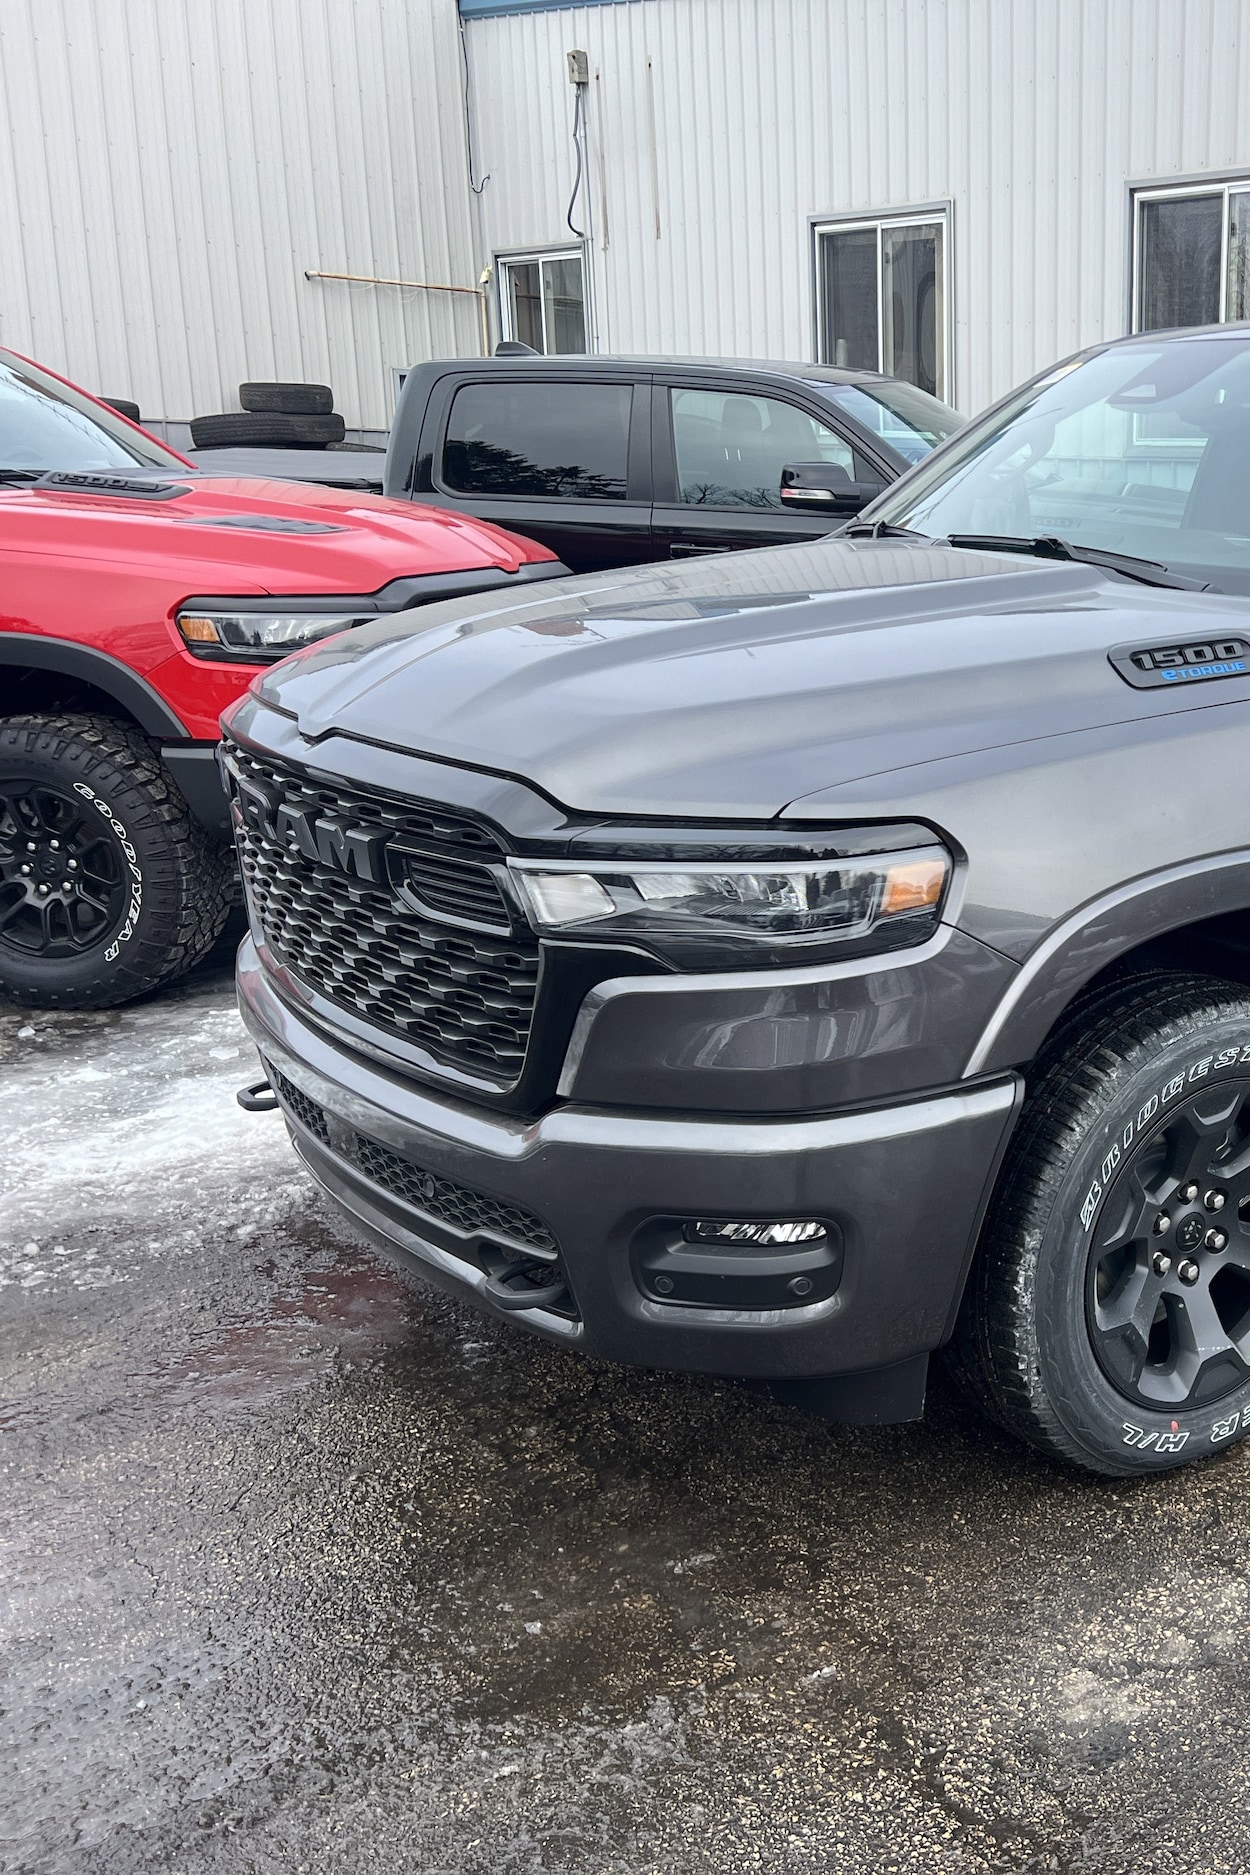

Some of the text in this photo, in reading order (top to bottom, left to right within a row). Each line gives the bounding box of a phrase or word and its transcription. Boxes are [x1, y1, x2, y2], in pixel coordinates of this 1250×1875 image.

[1132, 641, 1243, 671] 1500
[239, 777, 391, 884] RAM
[72, 782, 143, 962] GOODYEAR
[1121, 1421, 1191, 1454] H/L
